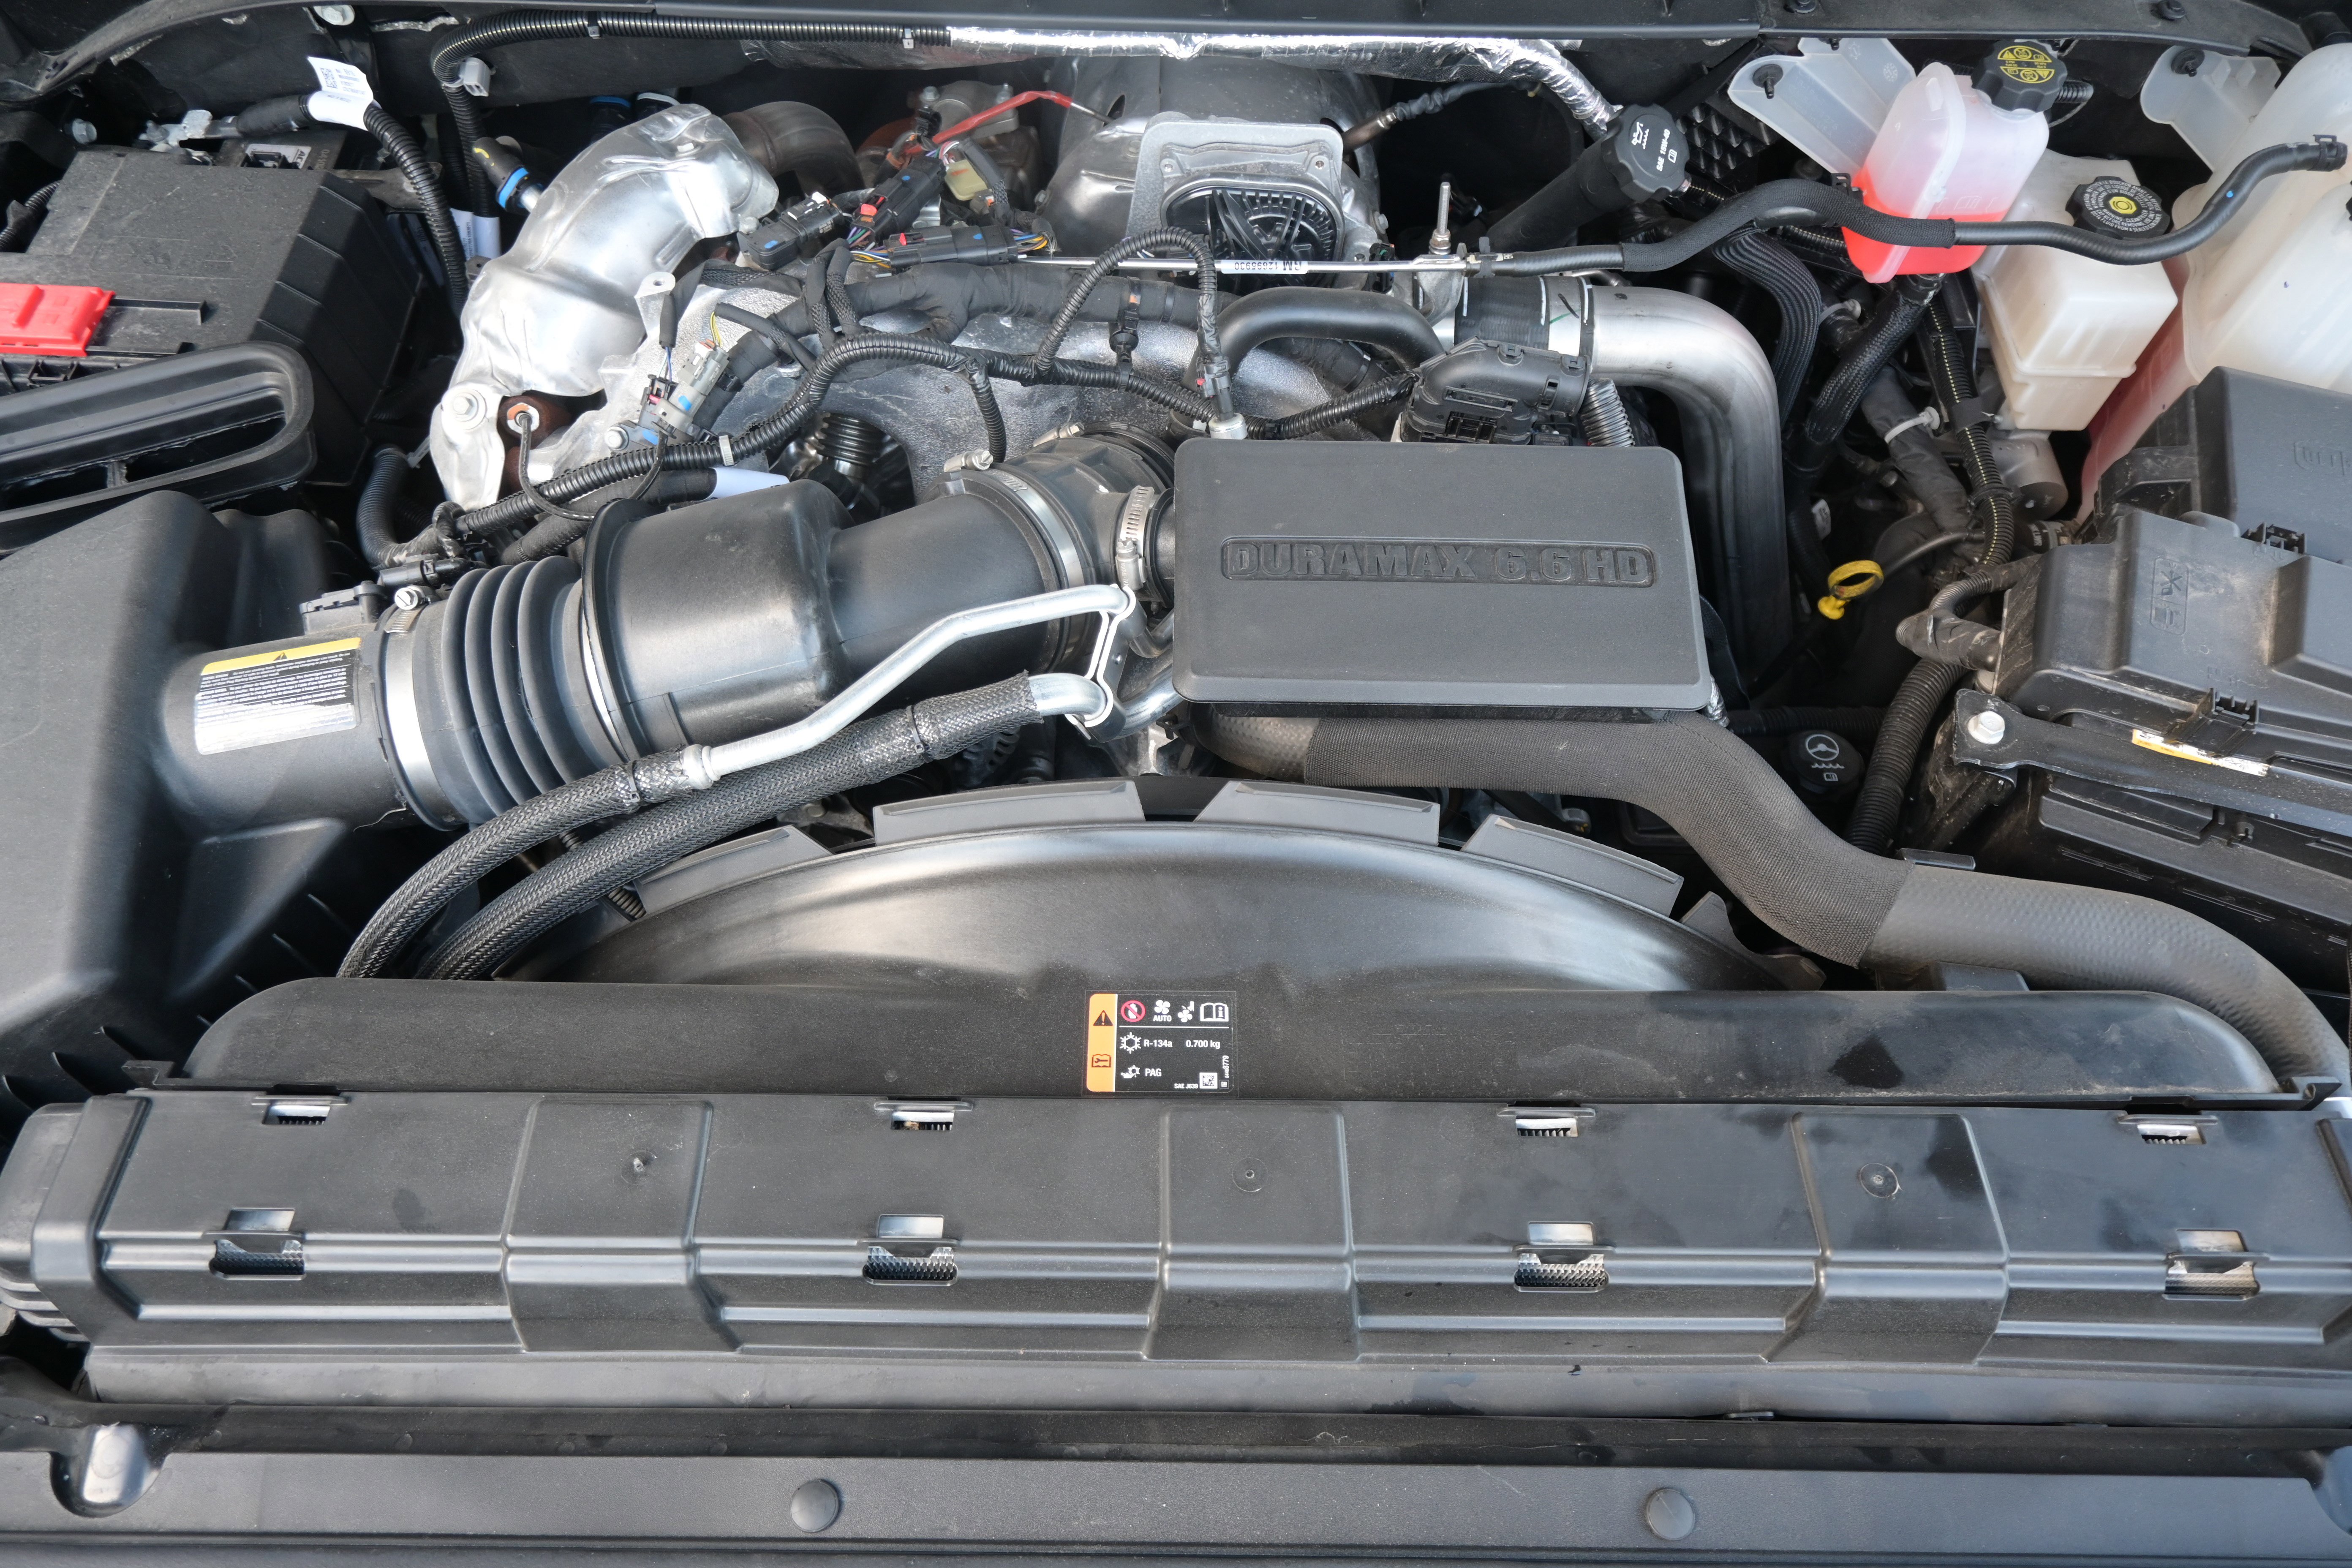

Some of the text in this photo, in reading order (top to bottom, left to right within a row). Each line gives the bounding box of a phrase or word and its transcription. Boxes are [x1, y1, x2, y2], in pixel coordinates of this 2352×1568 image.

[1656, 156, 1664, 172] SAE
[2120, 189, 2134, 197] BIDON
[2132, 186, 2147, 194] AVANT
[2103, 215, 2121, 225] BEFORE
[1234, 262, 1279, 270] 12695930
[1228, 543, 1652, 584] DURAMAX 6.6 HD
[1144, 1039, 1220, 1049] R-134a 0.700 kg
[1145, 1068, 1162, 1077] PAG
